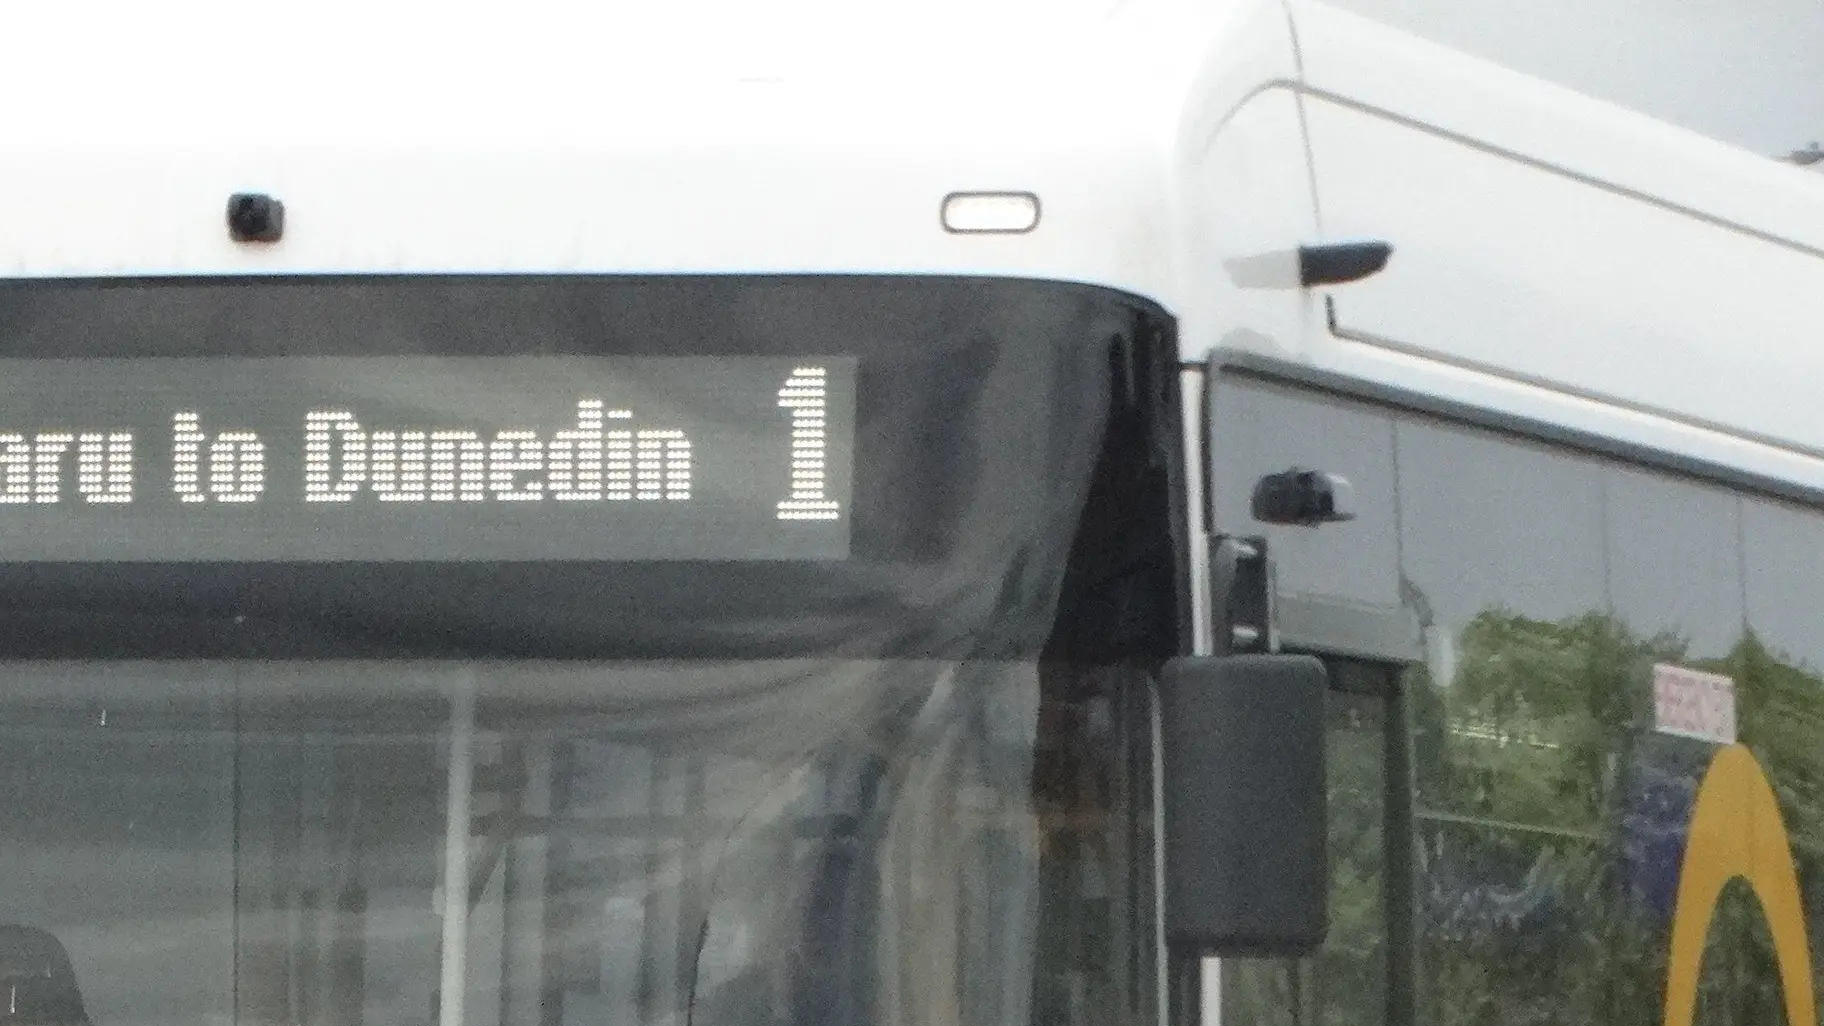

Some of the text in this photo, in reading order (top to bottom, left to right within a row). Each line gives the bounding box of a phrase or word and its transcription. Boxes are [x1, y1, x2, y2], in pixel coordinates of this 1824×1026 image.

[174, 412, 265, 504] to
[305, 400, 694, 503] Dunedin
[776, 367, 842, 521] 1
